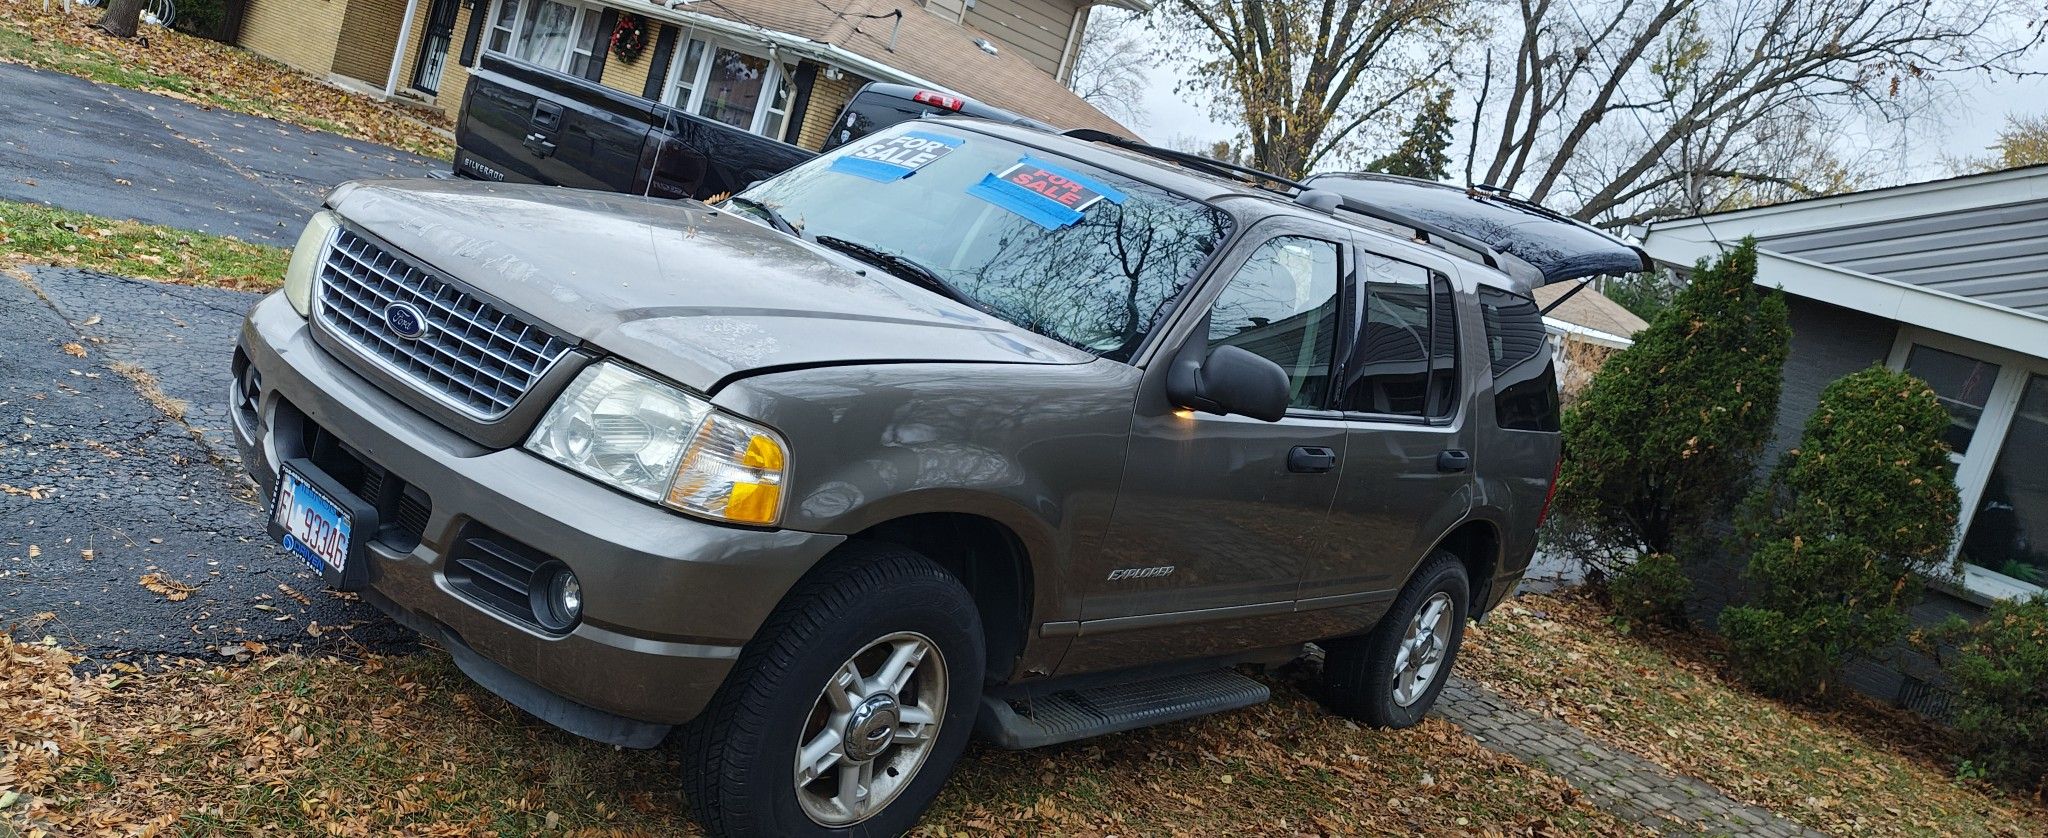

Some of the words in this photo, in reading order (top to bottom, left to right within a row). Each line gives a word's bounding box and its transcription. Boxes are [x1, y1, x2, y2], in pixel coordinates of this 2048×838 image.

[855, 144, 938, 168] SALE
[886, 136, 944, 153] FOR
[464, 158, 504, 181] SILVERADO
[1033, 169, 1083, 193] FOR
[1012, 173, 1082, 205] SALE
[392, 309, 414, 331] Ford
[277, 489, 293, 532] FL
[302, 508, 347, 569] 93346
[292, 550, 306, 563] AUTO
[293, 540, 325, 573] DRIVEN
[1107, 565, 1175, 580] EXPLORER
